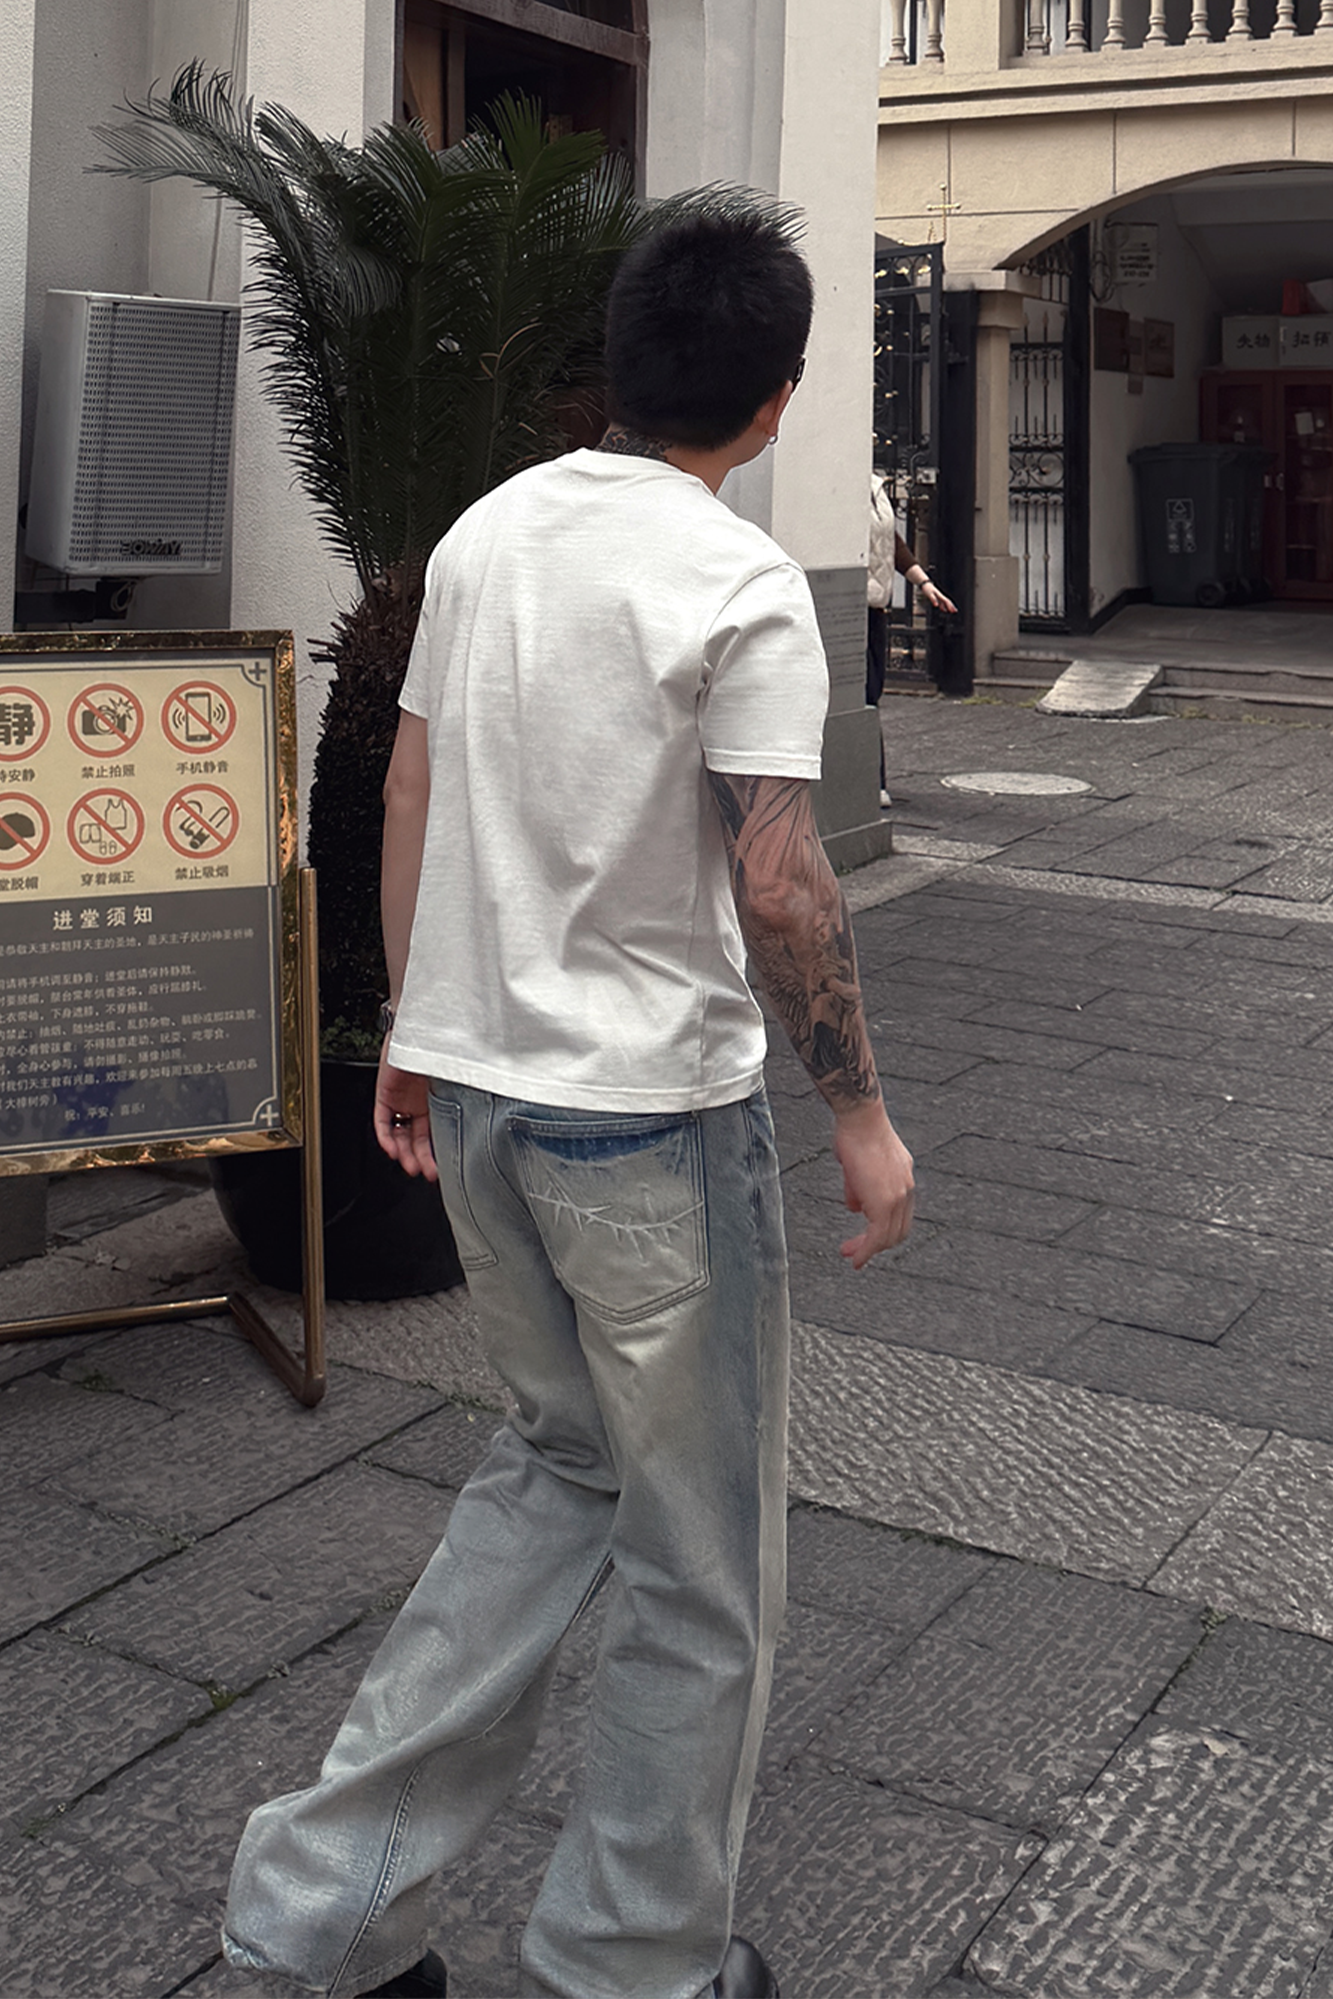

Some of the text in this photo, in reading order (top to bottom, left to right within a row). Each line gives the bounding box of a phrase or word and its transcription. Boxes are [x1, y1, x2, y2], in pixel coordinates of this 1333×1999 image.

[1236, 332, 1271, 349] 失物
[0, 702, 36, 746] 静
[81, 764, 136, 779] 禁止拍照
[175, 760, 229, 775] 手机静音
[80, 870, 135, 887] 穿着端正
[174, 865, 229, 881] 禁止吸烟
[52, 905, 153, 931] 进堂须知
